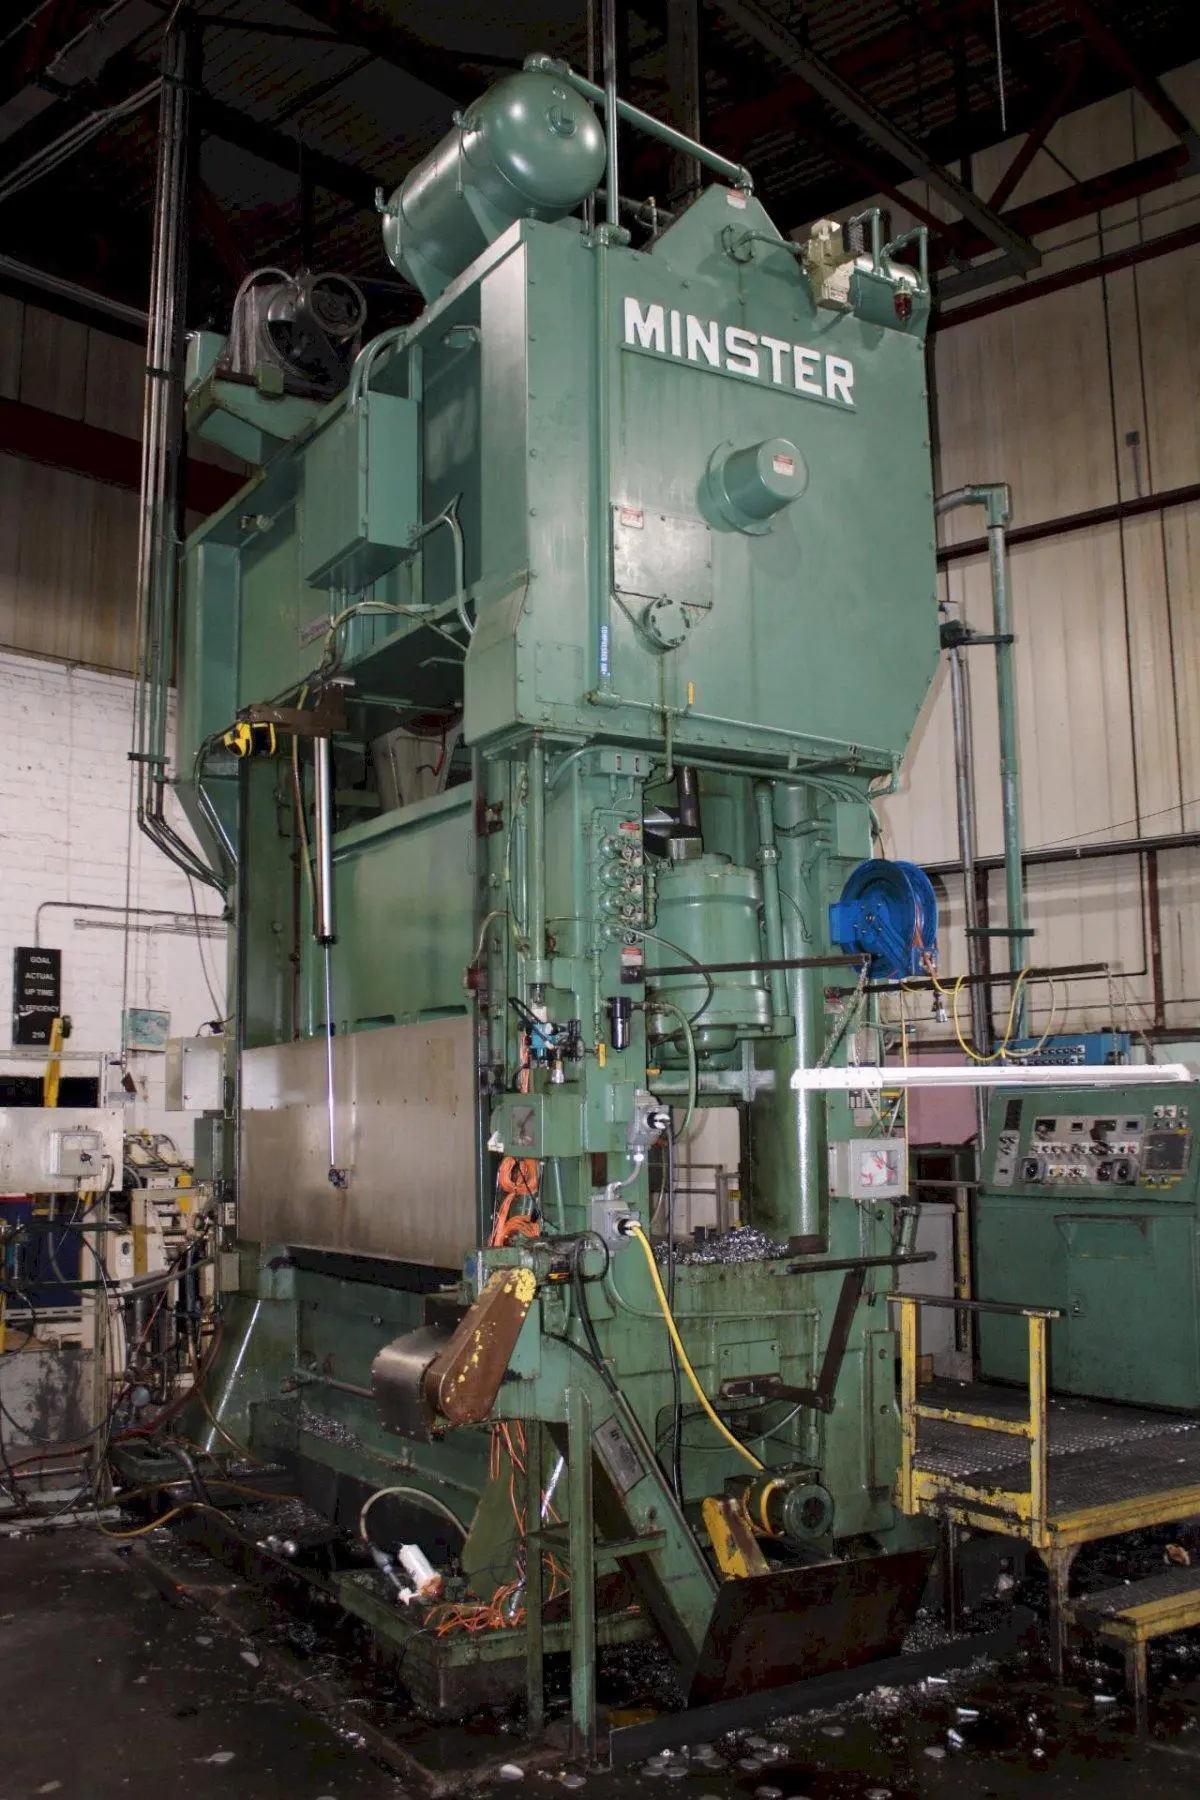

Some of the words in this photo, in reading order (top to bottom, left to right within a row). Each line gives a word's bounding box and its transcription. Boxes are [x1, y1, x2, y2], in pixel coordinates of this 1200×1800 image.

[624, 297, 855, 405] MINSTER
[30, 956, 51, 964] GOAL
[25, 972, 55, 981] ACTUAL
[24, 988, 36, 996] UP
[37, 989, 54, 997] TIME
